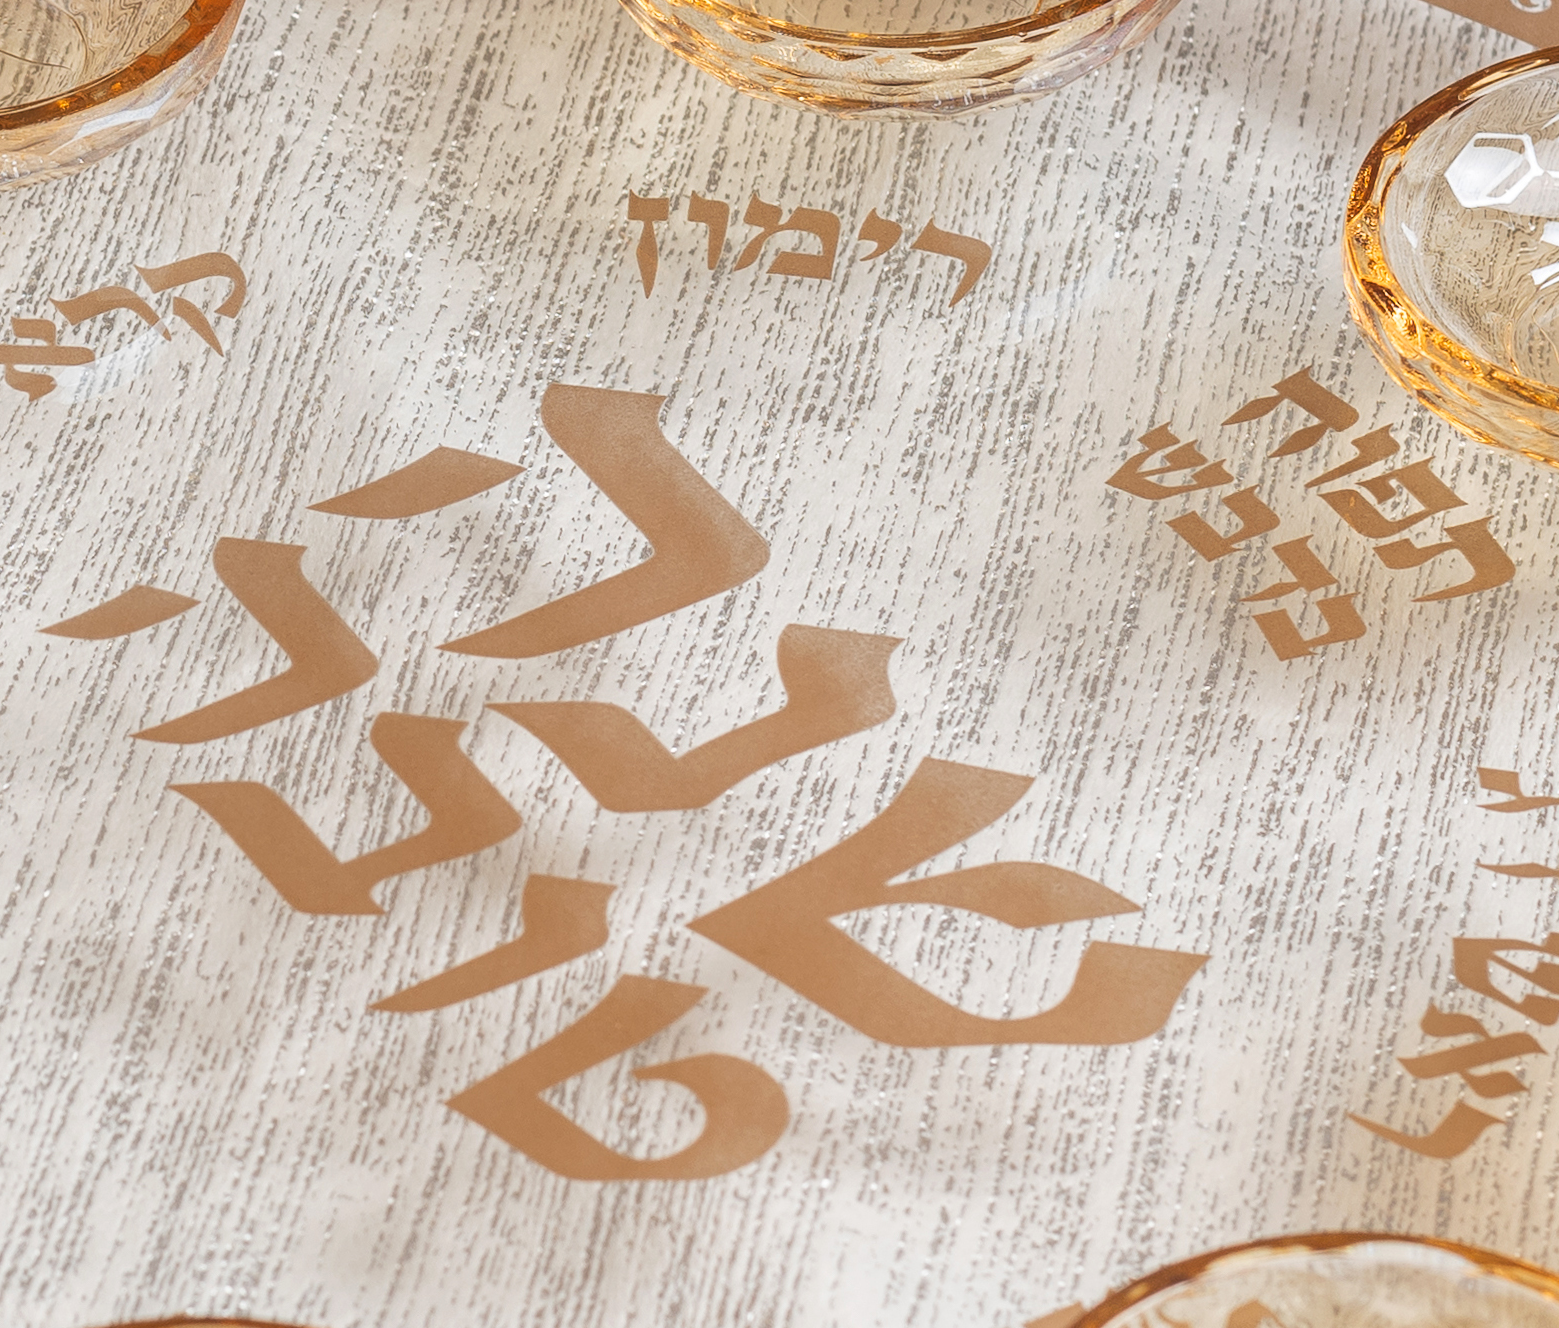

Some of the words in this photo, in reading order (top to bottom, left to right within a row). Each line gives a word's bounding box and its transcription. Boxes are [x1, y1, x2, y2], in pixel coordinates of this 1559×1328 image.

[628, 189, 993, 308] רימון
[1221, 367, 1516, 603] תפוח
[38, 536, 790, 1182] טובה
[306, 383, 1211, 1048] שנה
